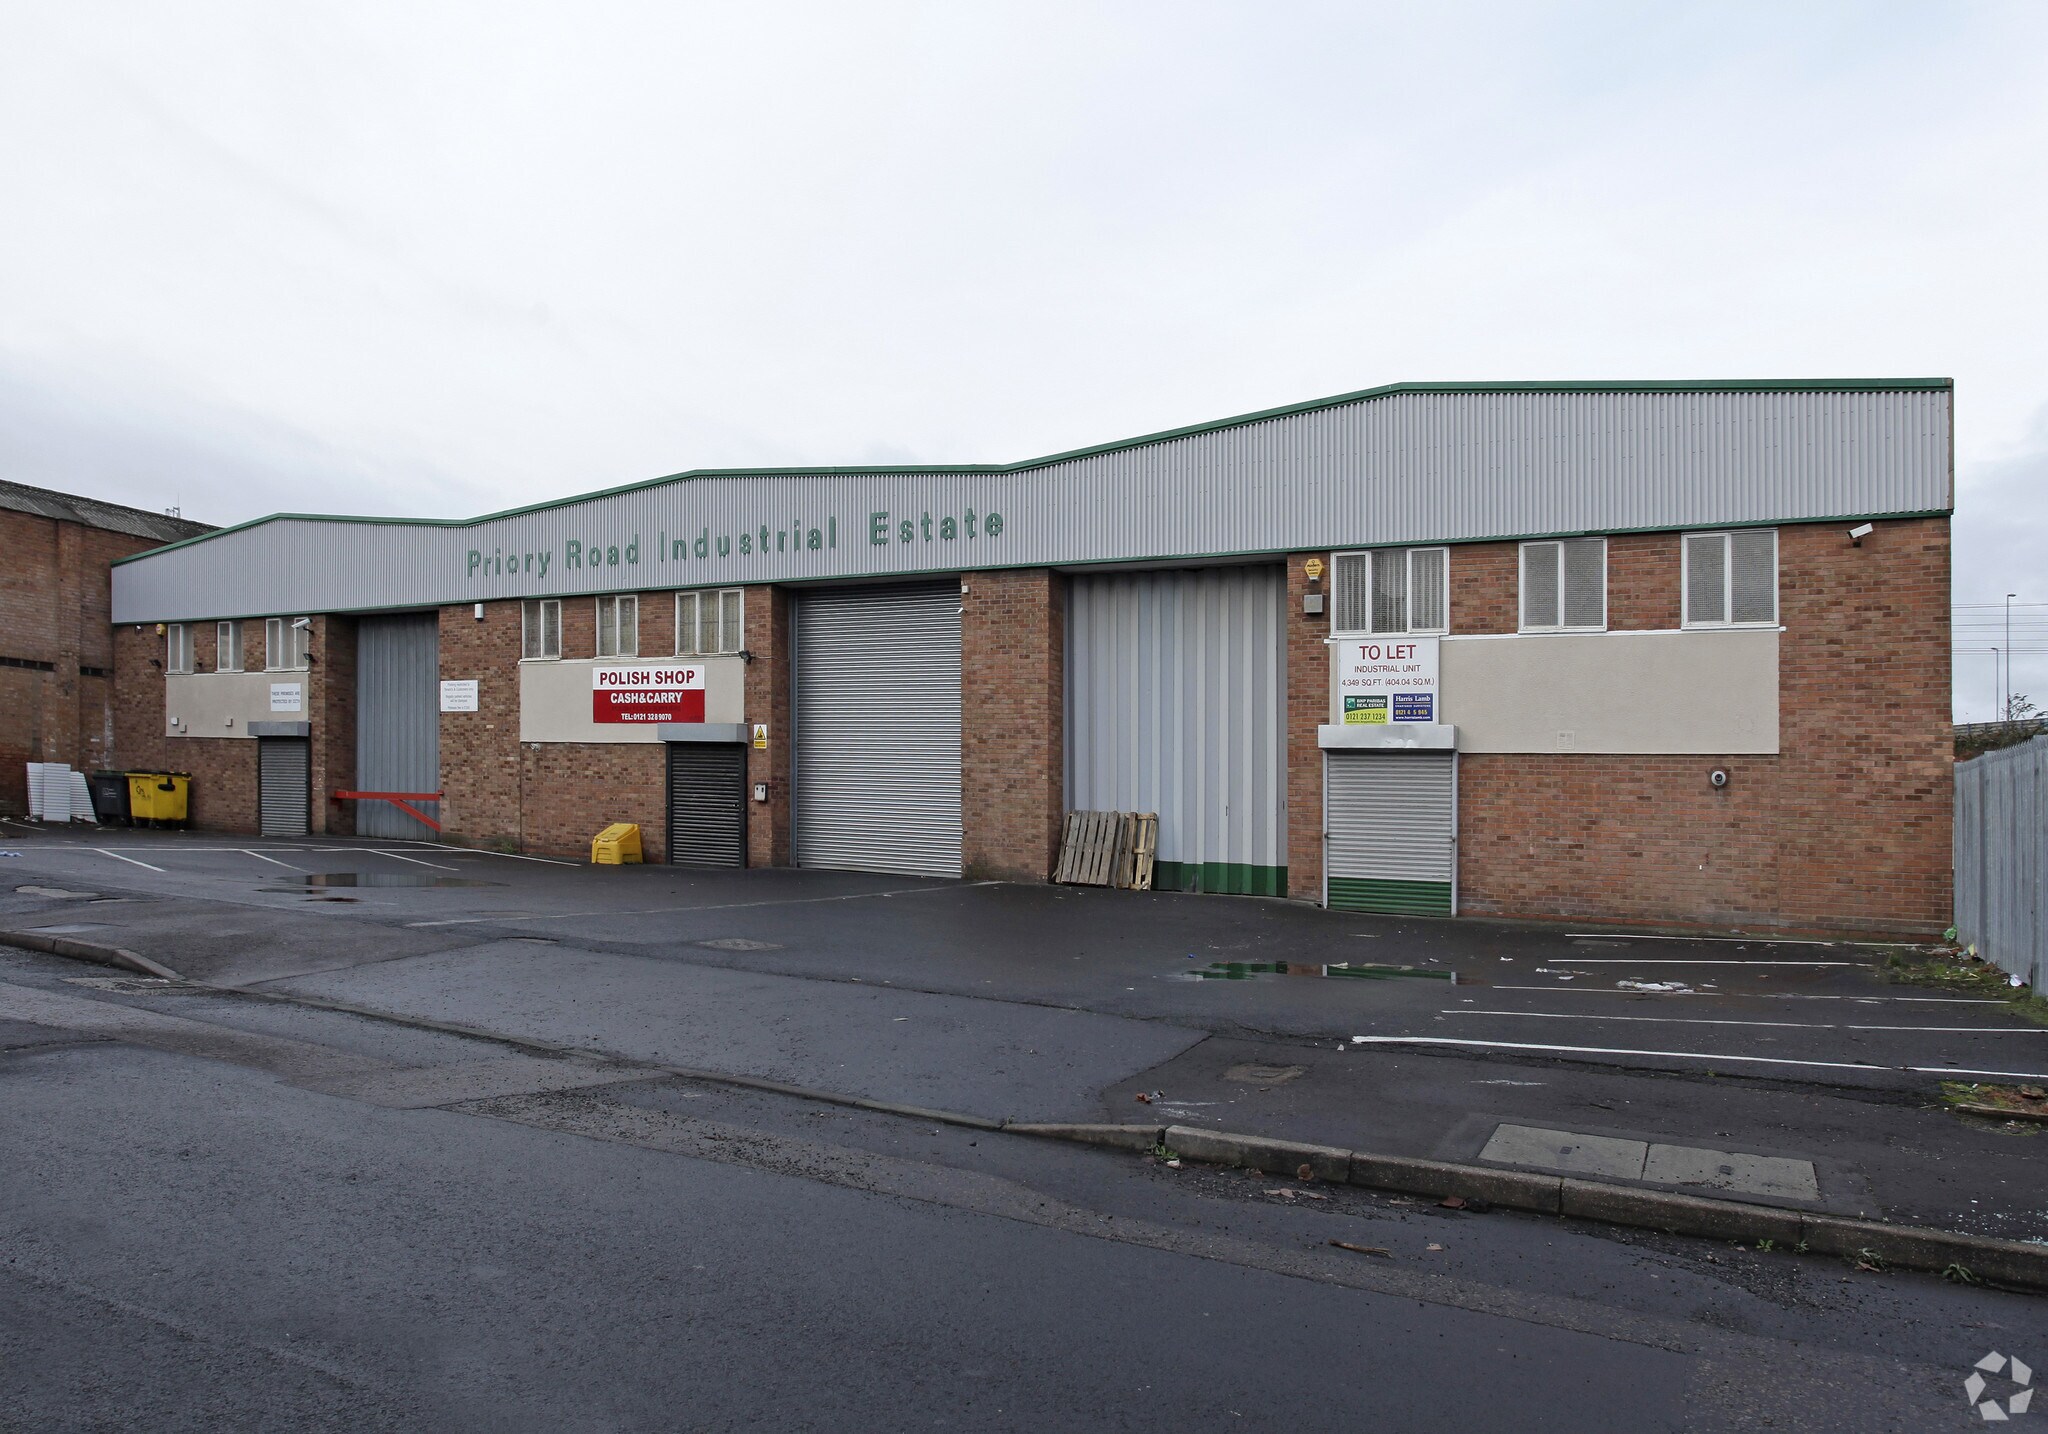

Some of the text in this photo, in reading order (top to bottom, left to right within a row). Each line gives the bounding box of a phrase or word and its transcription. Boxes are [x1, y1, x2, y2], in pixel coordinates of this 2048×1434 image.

[467, 508, 1004, 578] Priory Road Industrial Estate
[1359, 645, 1416, 660] TO LET
[1354, 664, 1421, 673] INDUSTRIAL UNIT
[600, 670, 695, 685] POLISH SHOP
[1385, 678, 1410, 686] (404.04
[610, 692, 683, 704] CASH&CARRY
